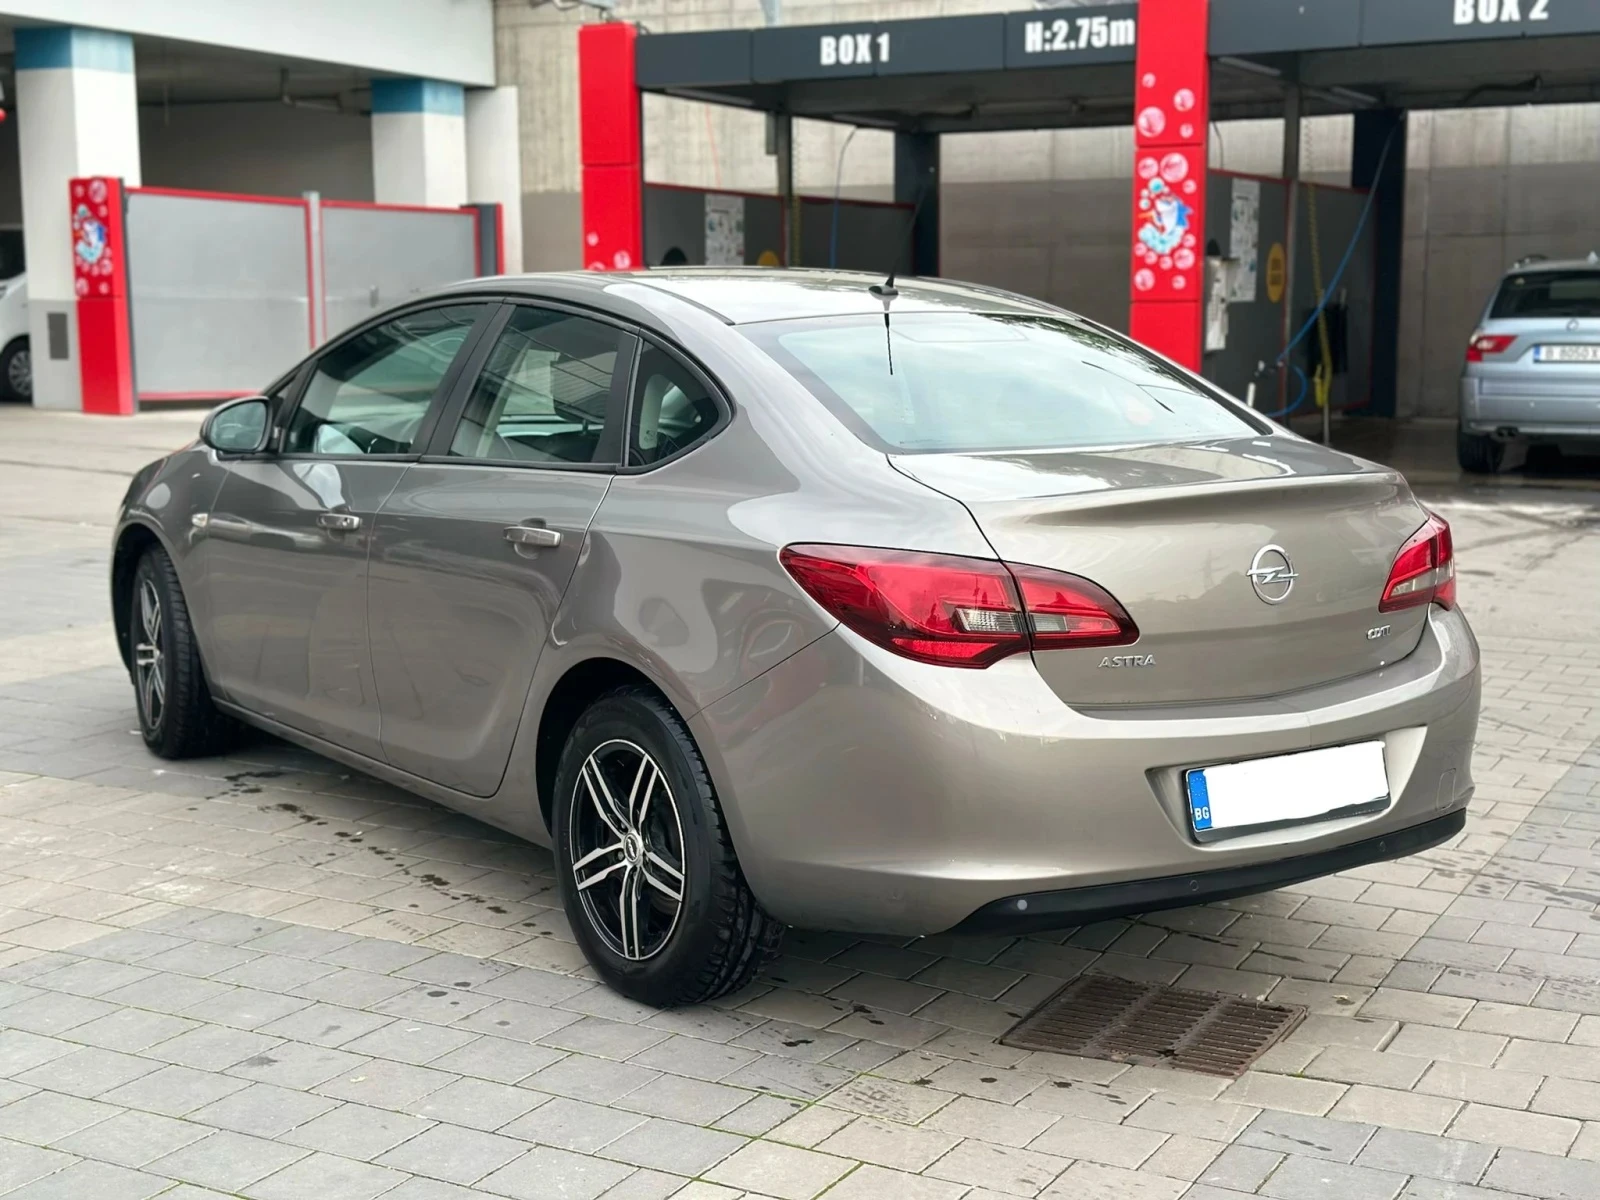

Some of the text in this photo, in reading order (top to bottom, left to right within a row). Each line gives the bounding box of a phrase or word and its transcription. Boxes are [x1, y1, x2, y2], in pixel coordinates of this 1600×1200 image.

[1453, 0, 1549, 25] BOX 2
[1025, 16, 1136, 53] H:2.75m
[820, 33, 890, 65] BOX 1
[1098, 654, 1157, 668] ASTRA
[1194, 806, 1210, 821] BG
